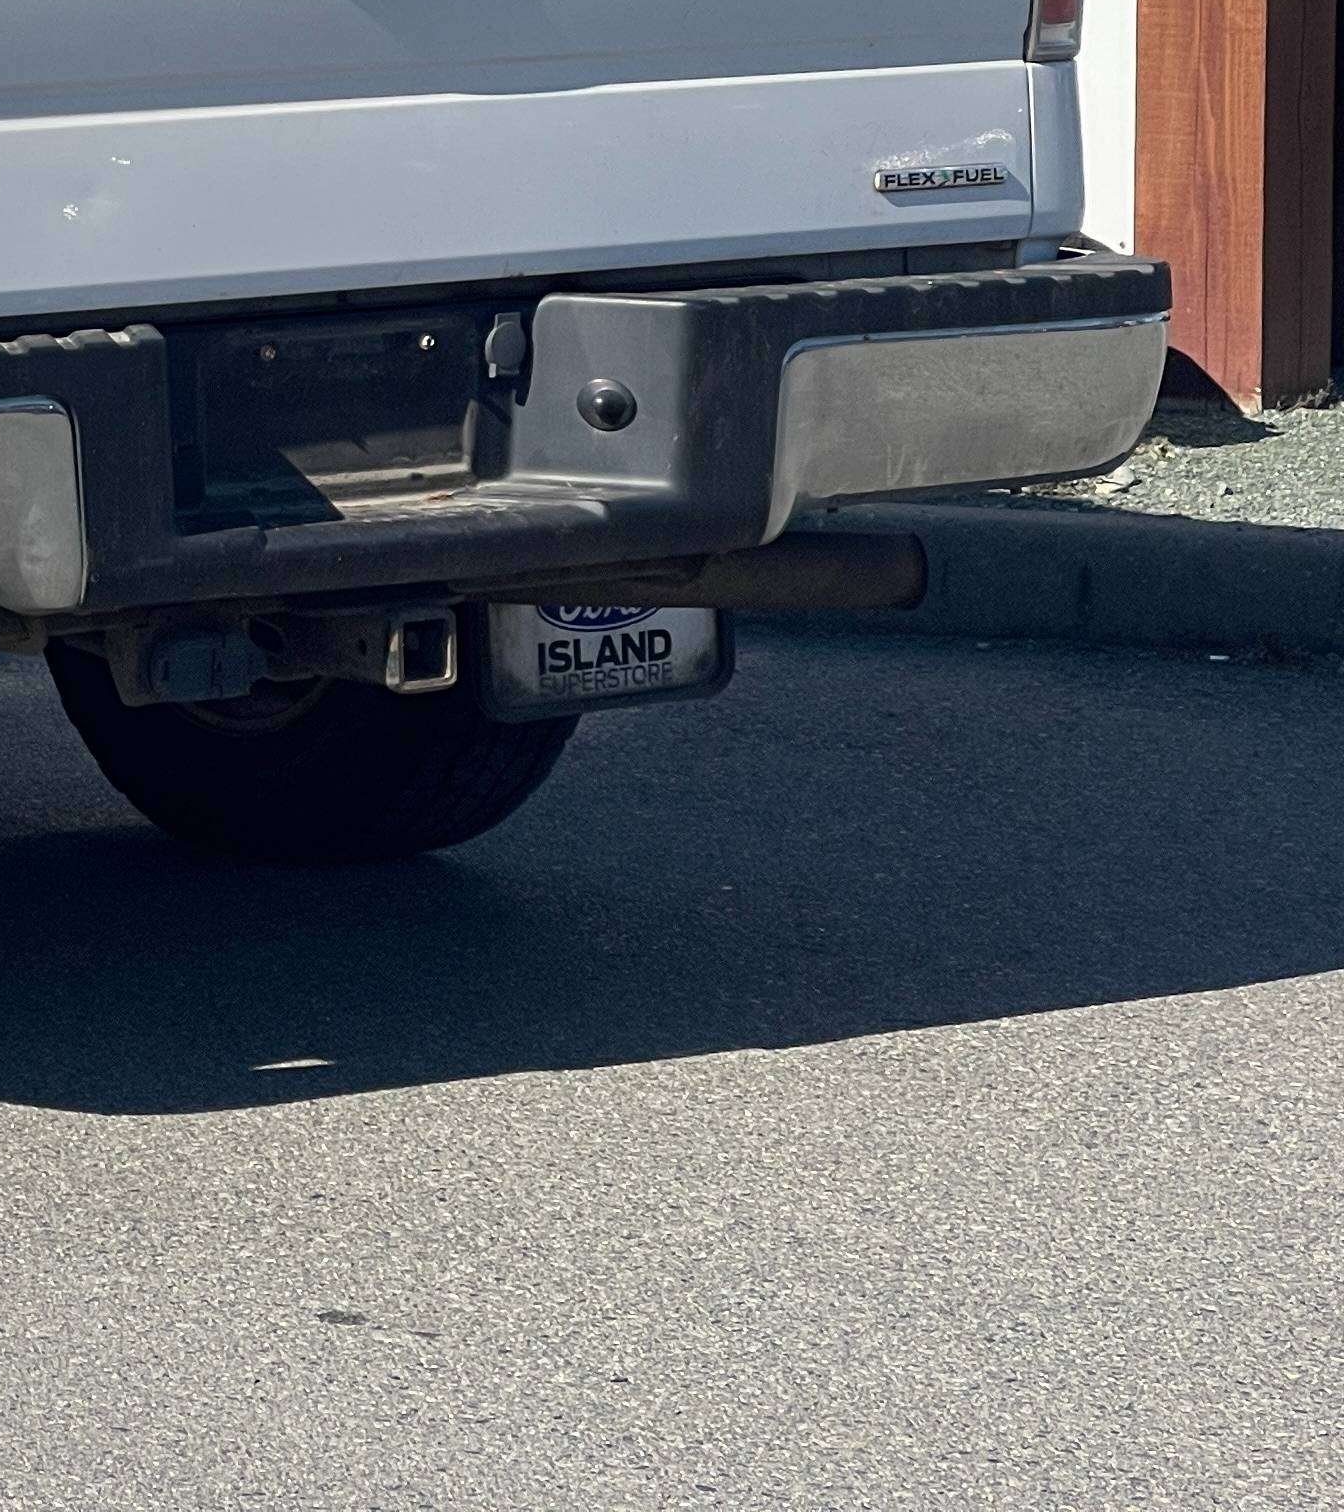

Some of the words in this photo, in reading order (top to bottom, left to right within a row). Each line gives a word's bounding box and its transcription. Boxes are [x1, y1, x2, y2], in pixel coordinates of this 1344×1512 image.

[884, 171, 936, 188] FLEX
[953, 167, 1004, 184] FUEL
[538, 629, 673, 676] ISLAND
